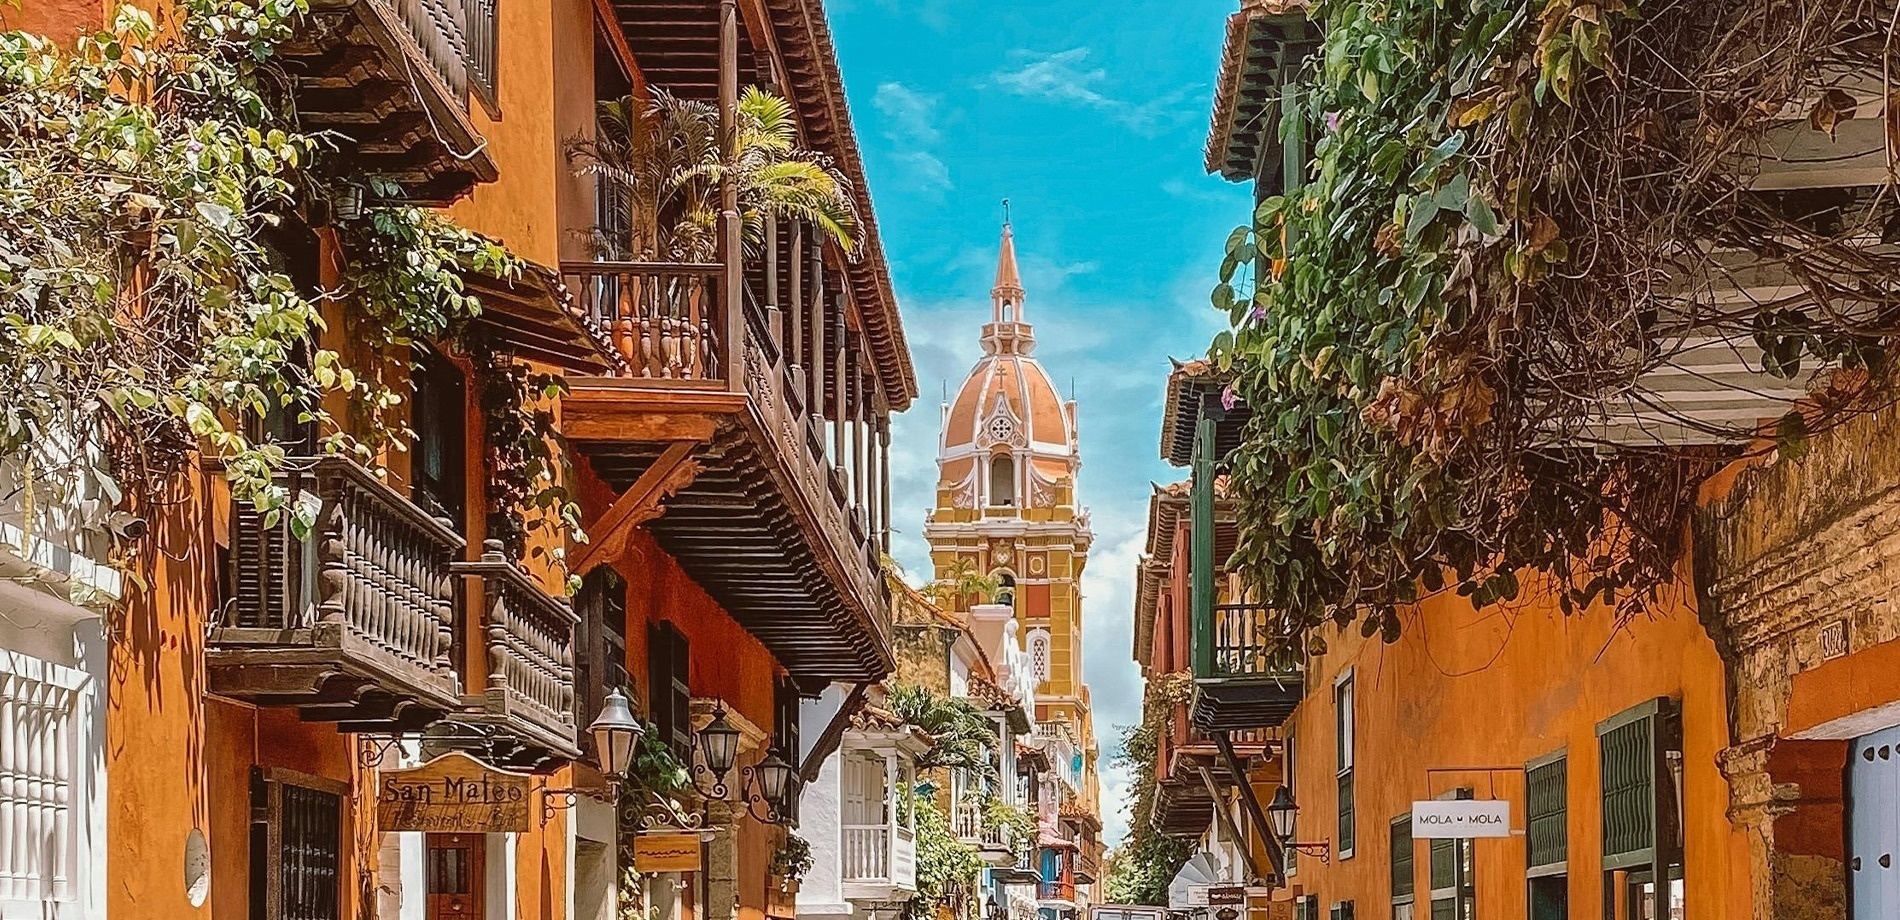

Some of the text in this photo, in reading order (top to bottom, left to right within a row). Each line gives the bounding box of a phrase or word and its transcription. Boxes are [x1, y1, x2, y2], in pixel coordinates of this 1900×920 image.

[385, 773, 522, 804] San Mateo
[1420, 814, 1502, 825] MOLA MOLA
